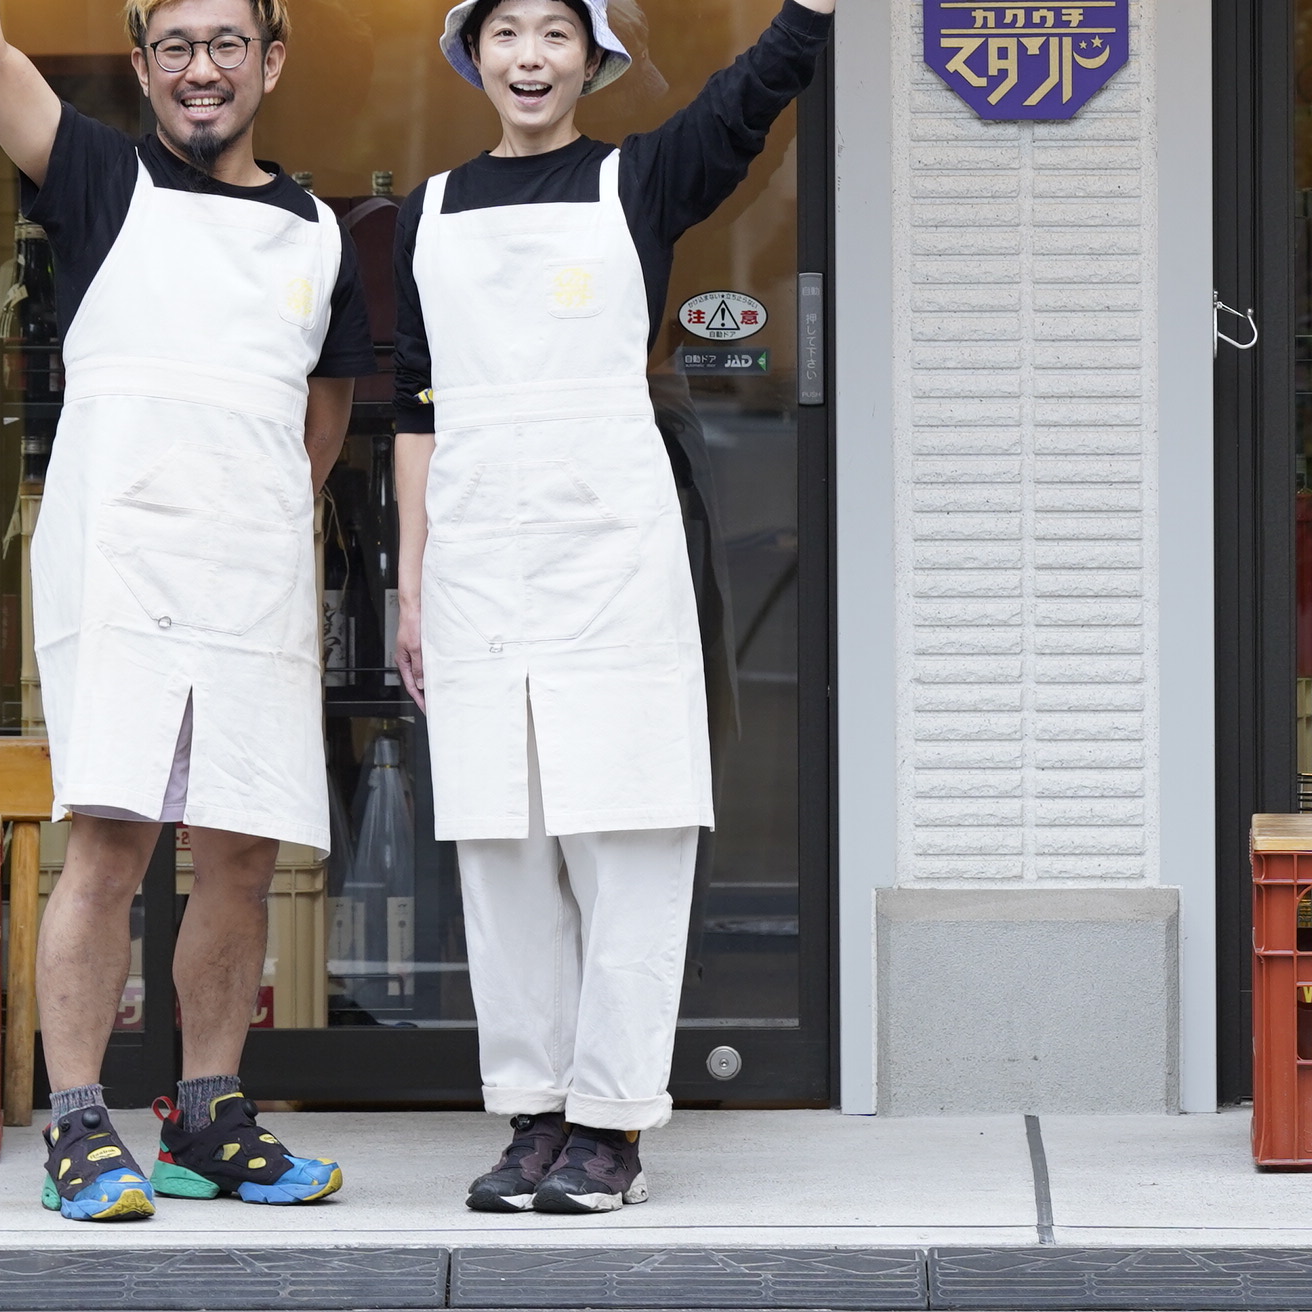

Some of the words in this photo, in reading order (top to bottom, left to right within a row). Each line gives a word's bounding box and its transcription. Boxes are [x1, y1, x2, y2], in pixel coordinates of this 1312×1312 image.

[971, 8, 1084, 28] カクウチ
[801, 286, 821, 296] 自動
[806, 313, 818, 380] 押して下さい
[684, 354, 717, 363] 自動ドア
